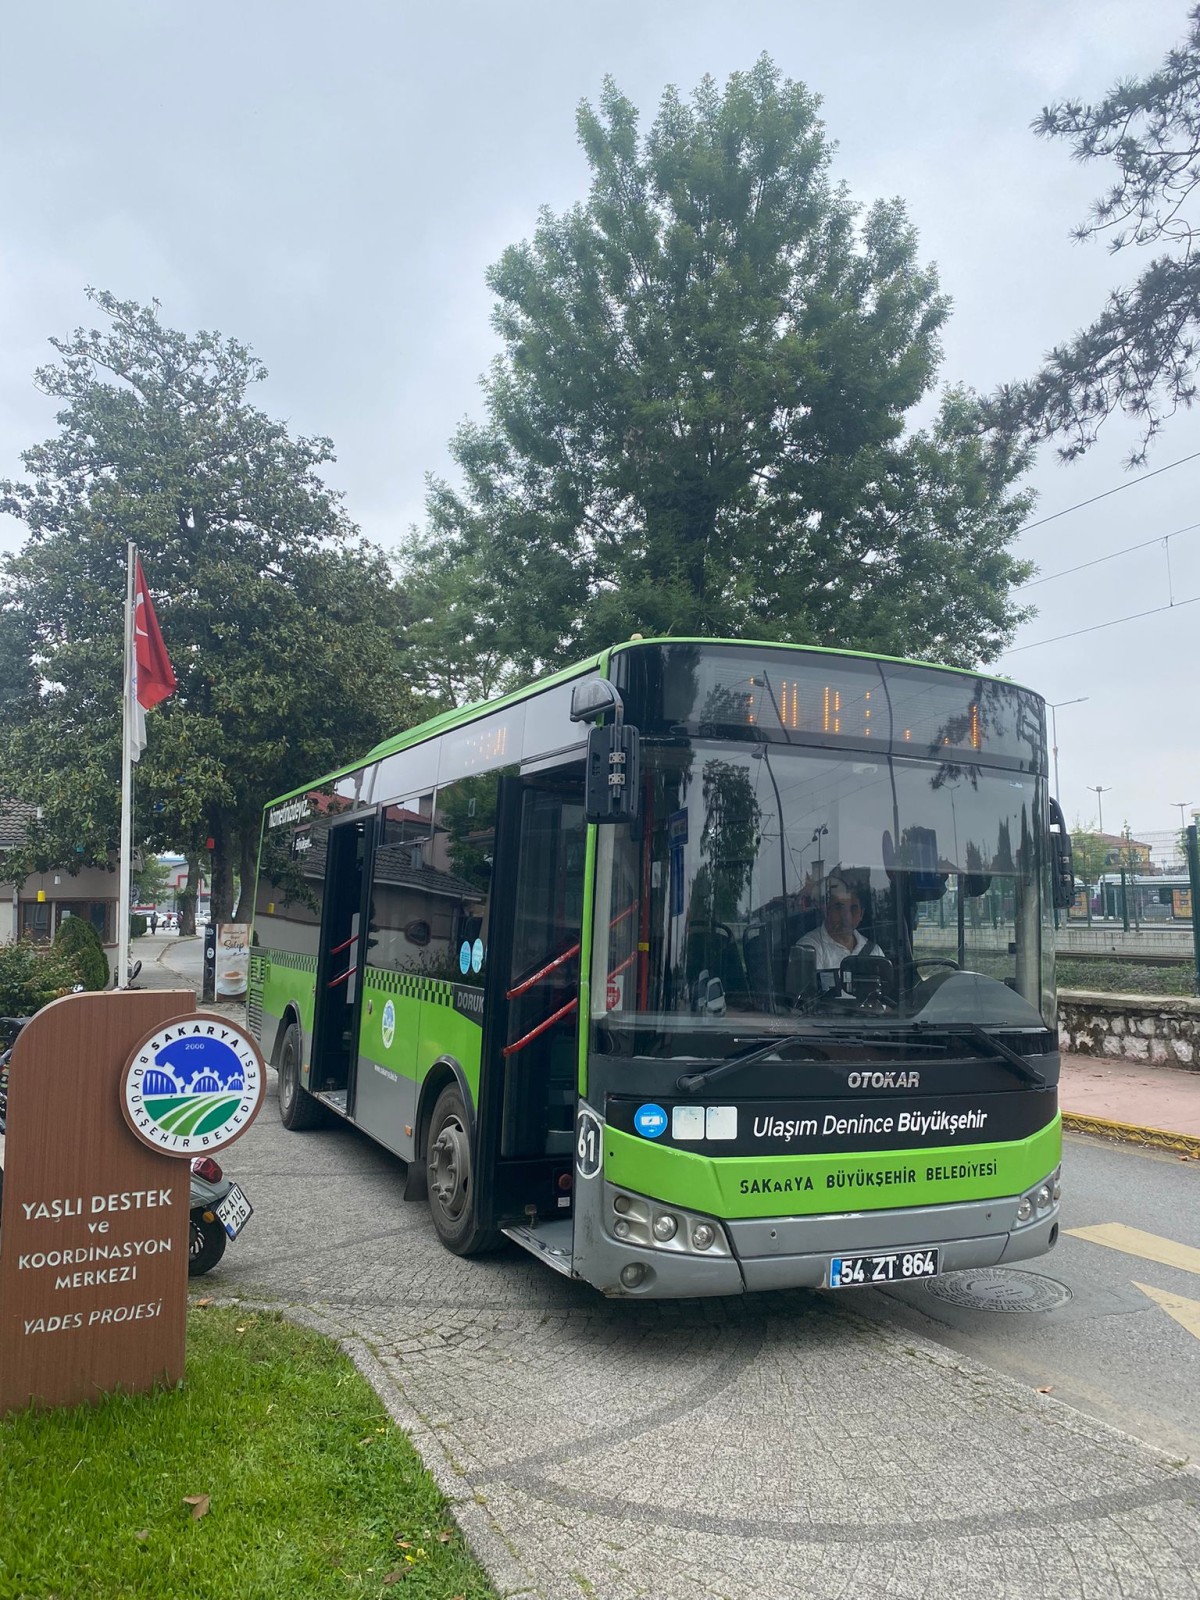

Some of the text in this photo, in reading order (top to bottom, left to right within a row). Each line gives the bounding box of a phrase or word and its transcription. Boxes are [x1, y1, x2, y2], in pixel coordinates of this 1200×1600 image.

[151, 1025, 239, 1051] SAKARYA
[848, 1071, 920, 1089] OTOKAR
[131, 1052, 256, 1147] BÜYÜKŞEHİR BELEDİYESİ
[753, 1109, 988, 1142] Ulaşım Denince Büyükşehir
[578, 1126, 595, 1162] 61
[740, 1159, 997, 1194] SAKARYA BÜYÜKŞEHİR BELEDİYESİ
[22, 1189, 173, 1223] YAŞLI DESTEK
[219, 1205, 230, 1222] 54
[232, 1205, 246, 1227] 216
[87, 1220, 110, 1234] ve
[18, 1238, 172, 1270] KOORDİNASYON
[841, 1259, 865, 1283] 54
[872, 1255, 897, 1280] ZT
[902, 1251, 934, 1276] 864
[55, 1261, 137, 1290] MERKEZİ
[23, 1298, 162, 1336] YADES PROJESİ
